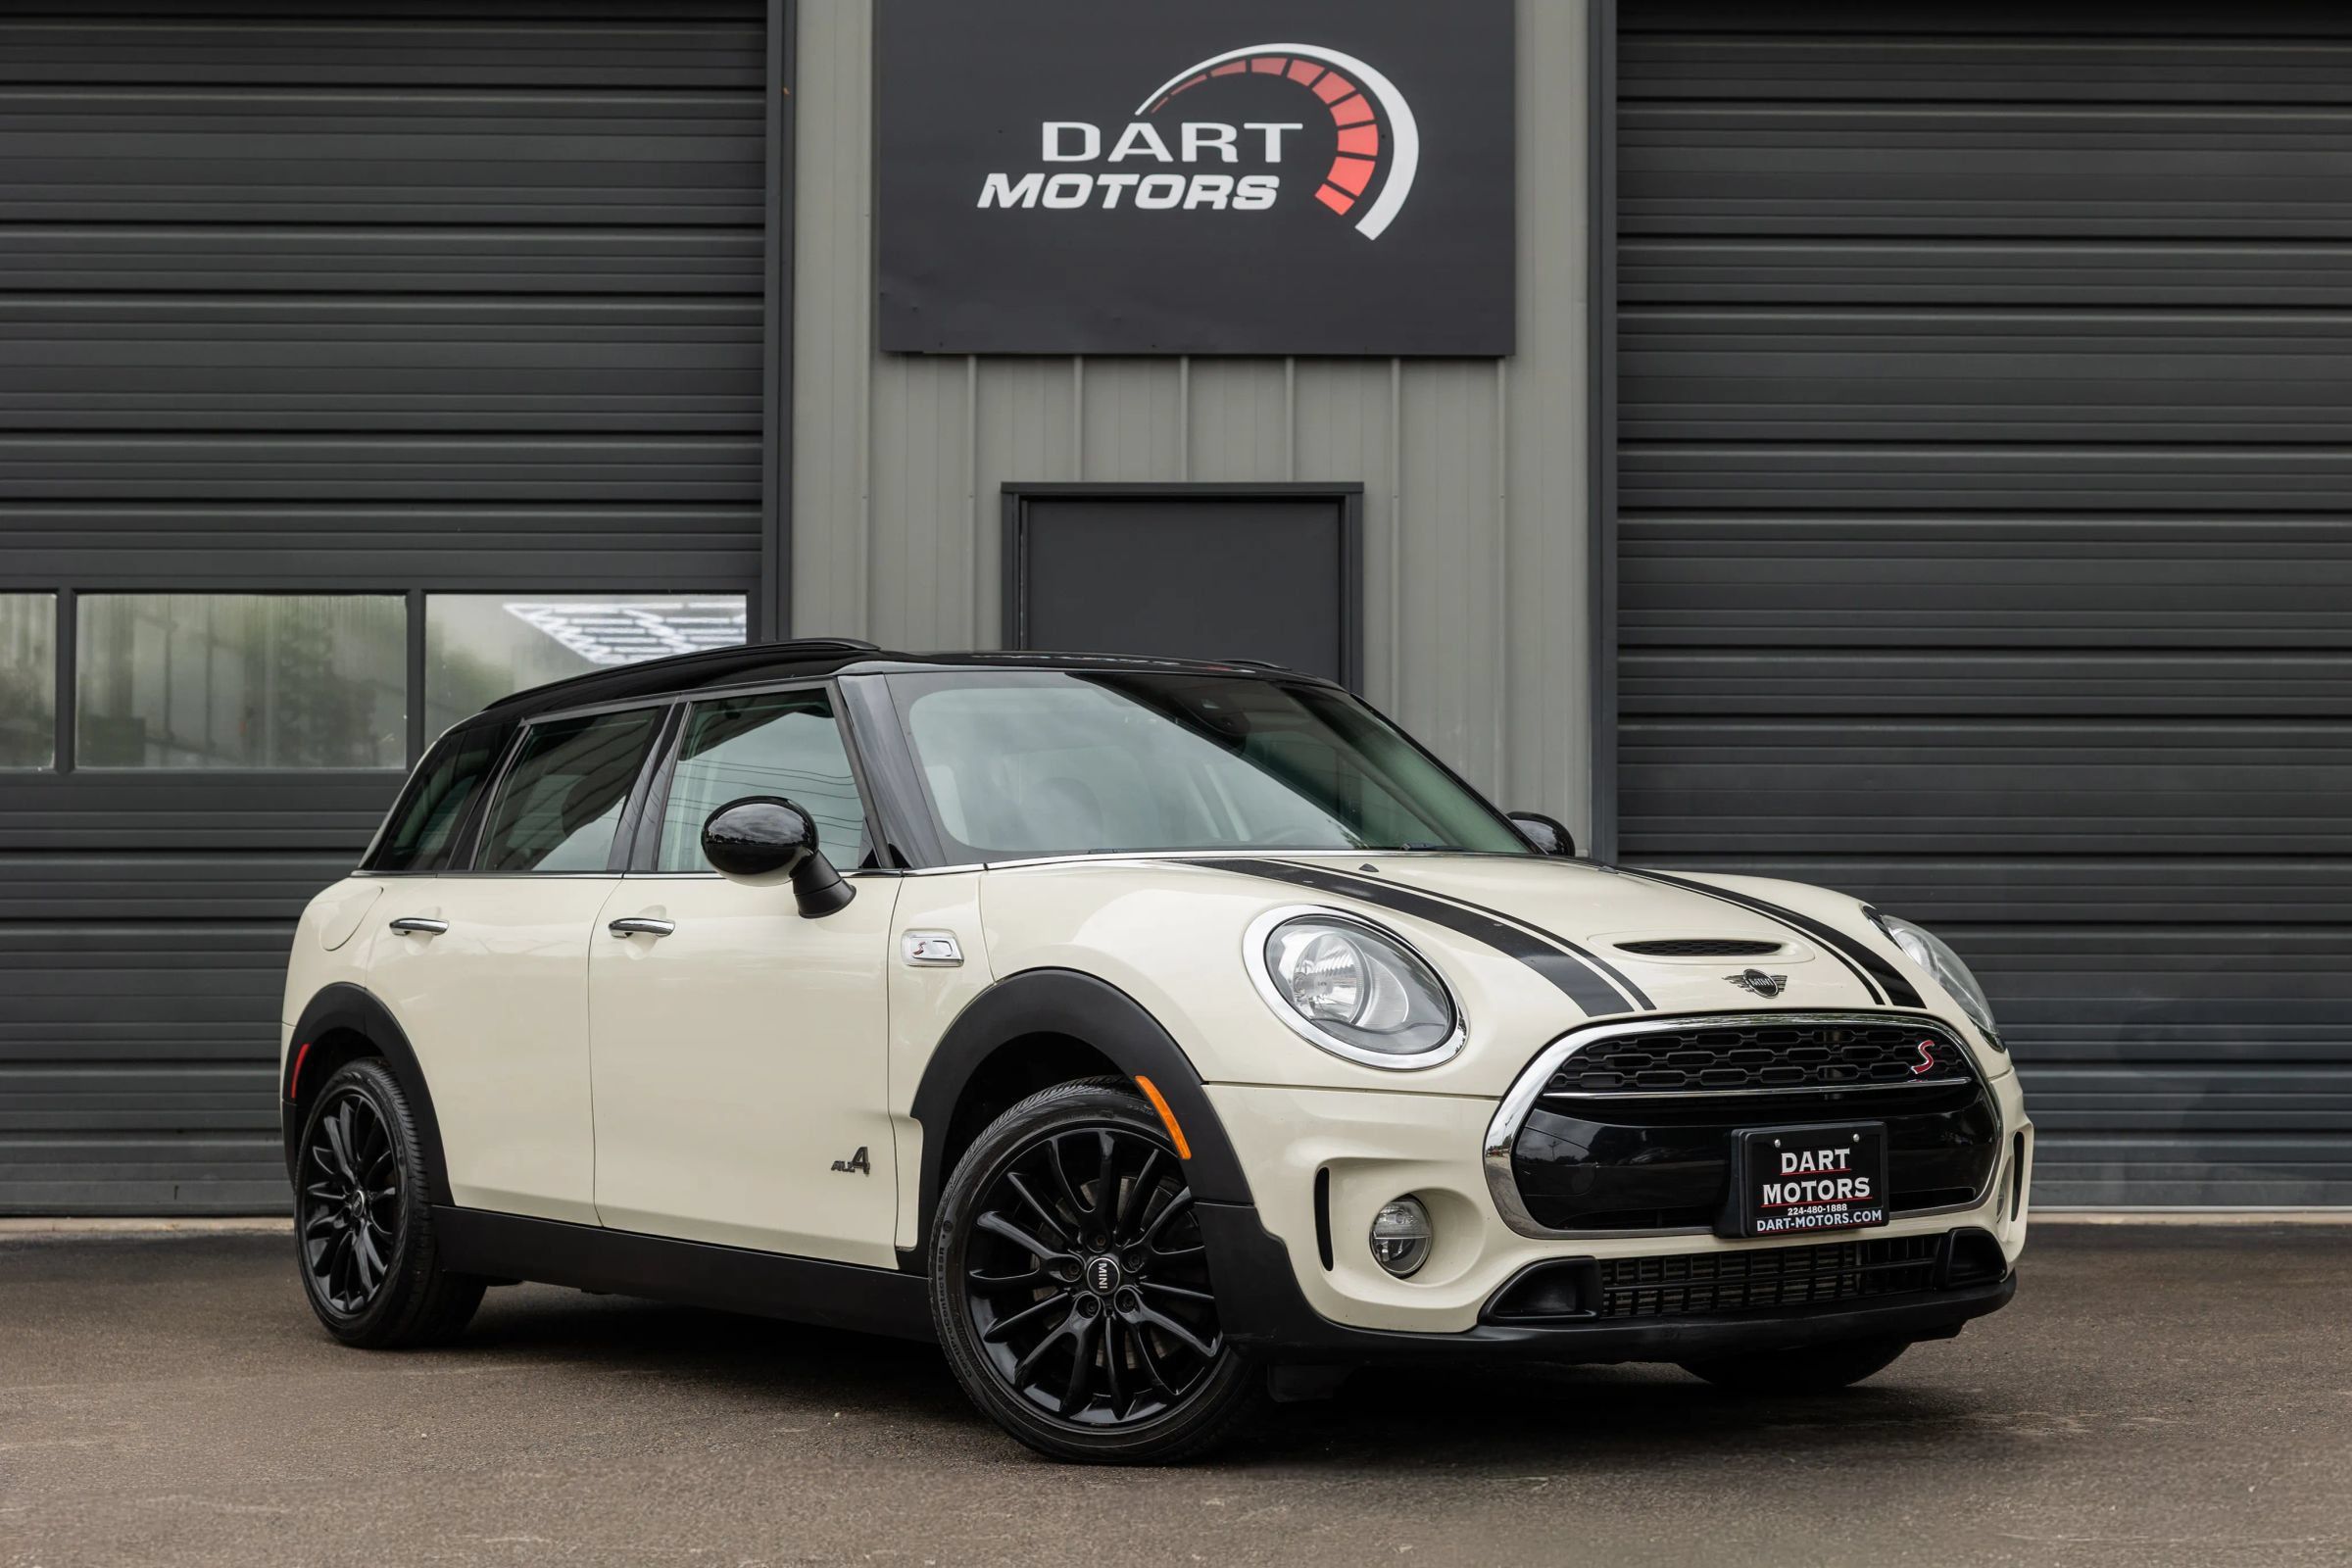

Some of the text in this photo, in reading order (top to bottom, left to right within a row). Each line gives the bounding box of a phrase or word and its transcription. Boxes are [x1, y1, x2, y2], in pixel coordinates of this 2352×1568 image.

[1042, 122, 1303, 163] DART
[977, 172, 1280, 210] MOTORS
[1781, 1148, 1850, 1174] DART
[1763, 1177, 1871, 1205] MOTORS
[1756, 1209, 1883, 1232] DART-MOTORS.COM
[1787, 1203, 1848, 1216] 224-480-1888
[1098, 1262, 1108, 1290] MINI
